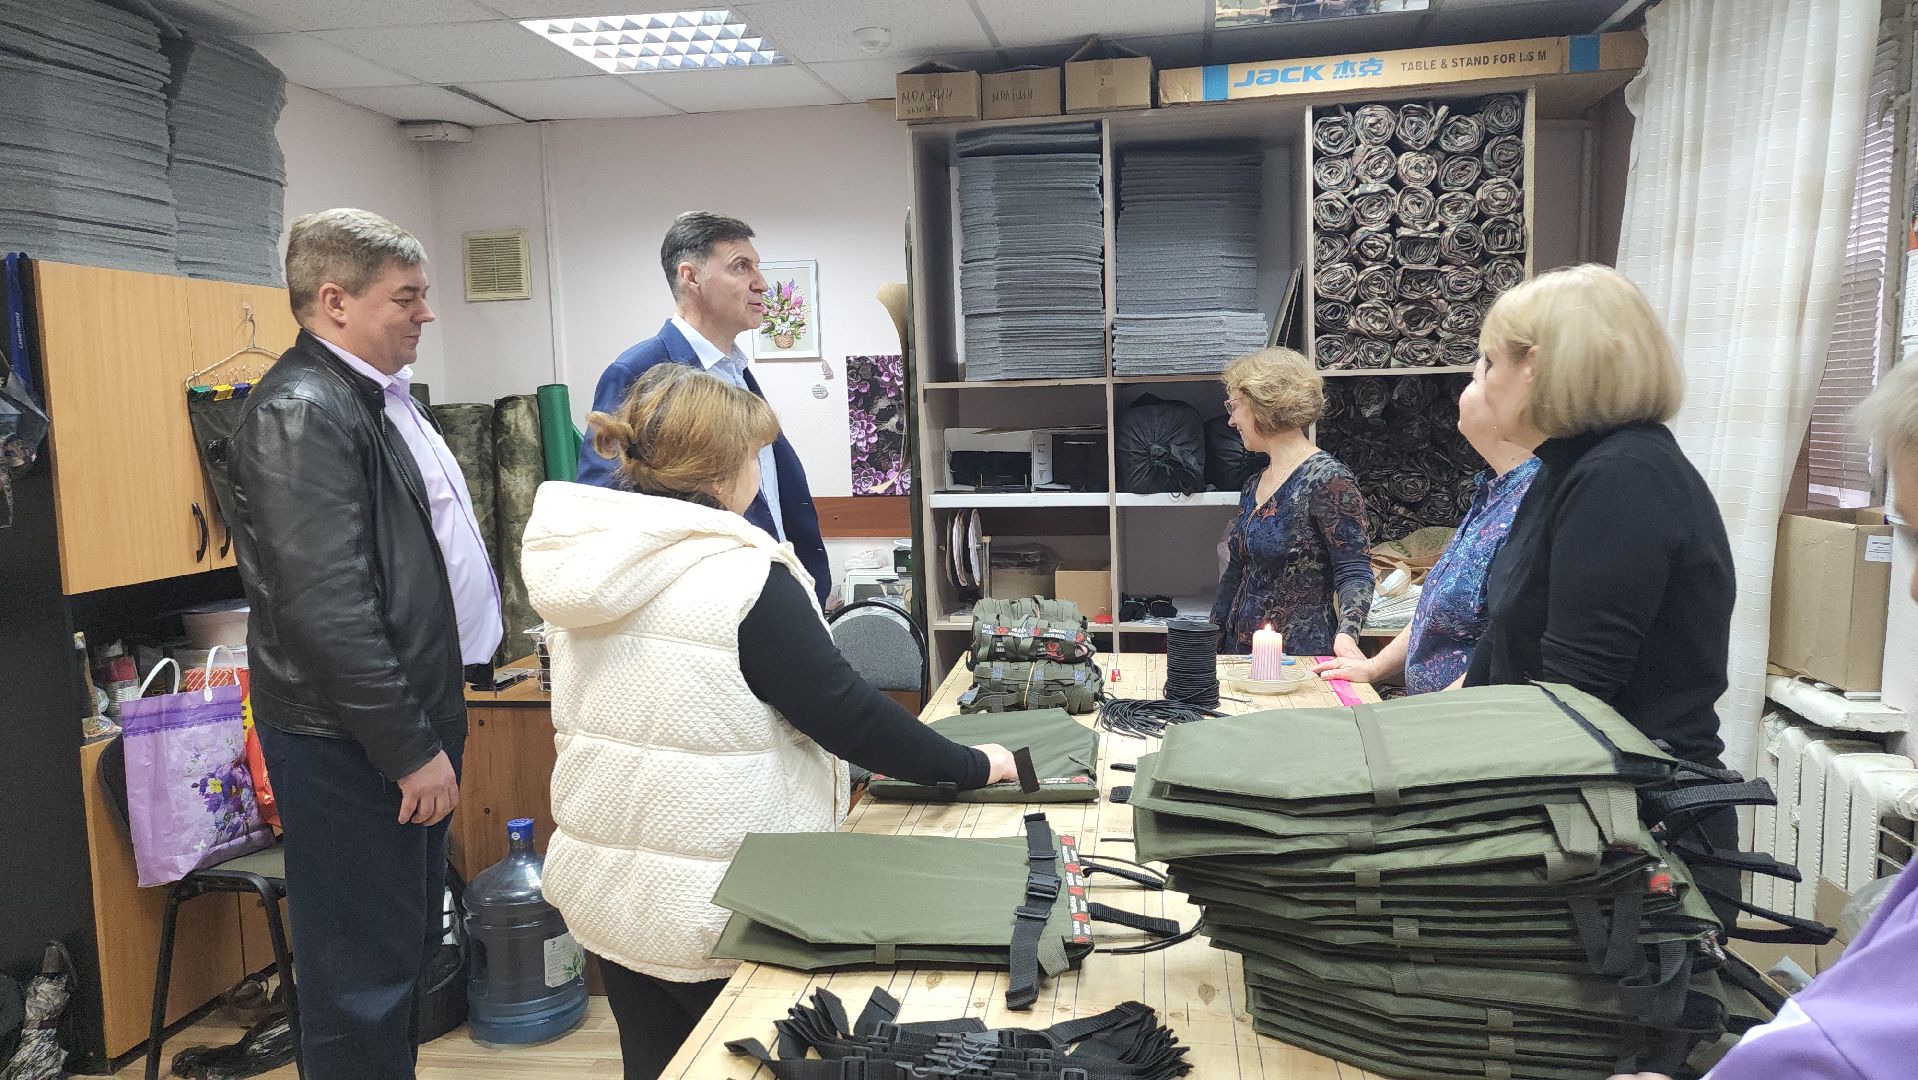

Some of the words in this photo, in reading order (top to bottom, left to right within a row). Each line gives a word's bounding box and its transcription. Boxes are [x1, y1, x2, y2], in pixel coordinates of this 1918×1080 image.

[1333, 57, 1383, 79] 杰克
[1401, 59, 1437, 72] TABLE
[1440, 58, 1448, 69] &
[1451, 55, 1490, 68] STAND
[1493, 53, 1516, 65] FOR
